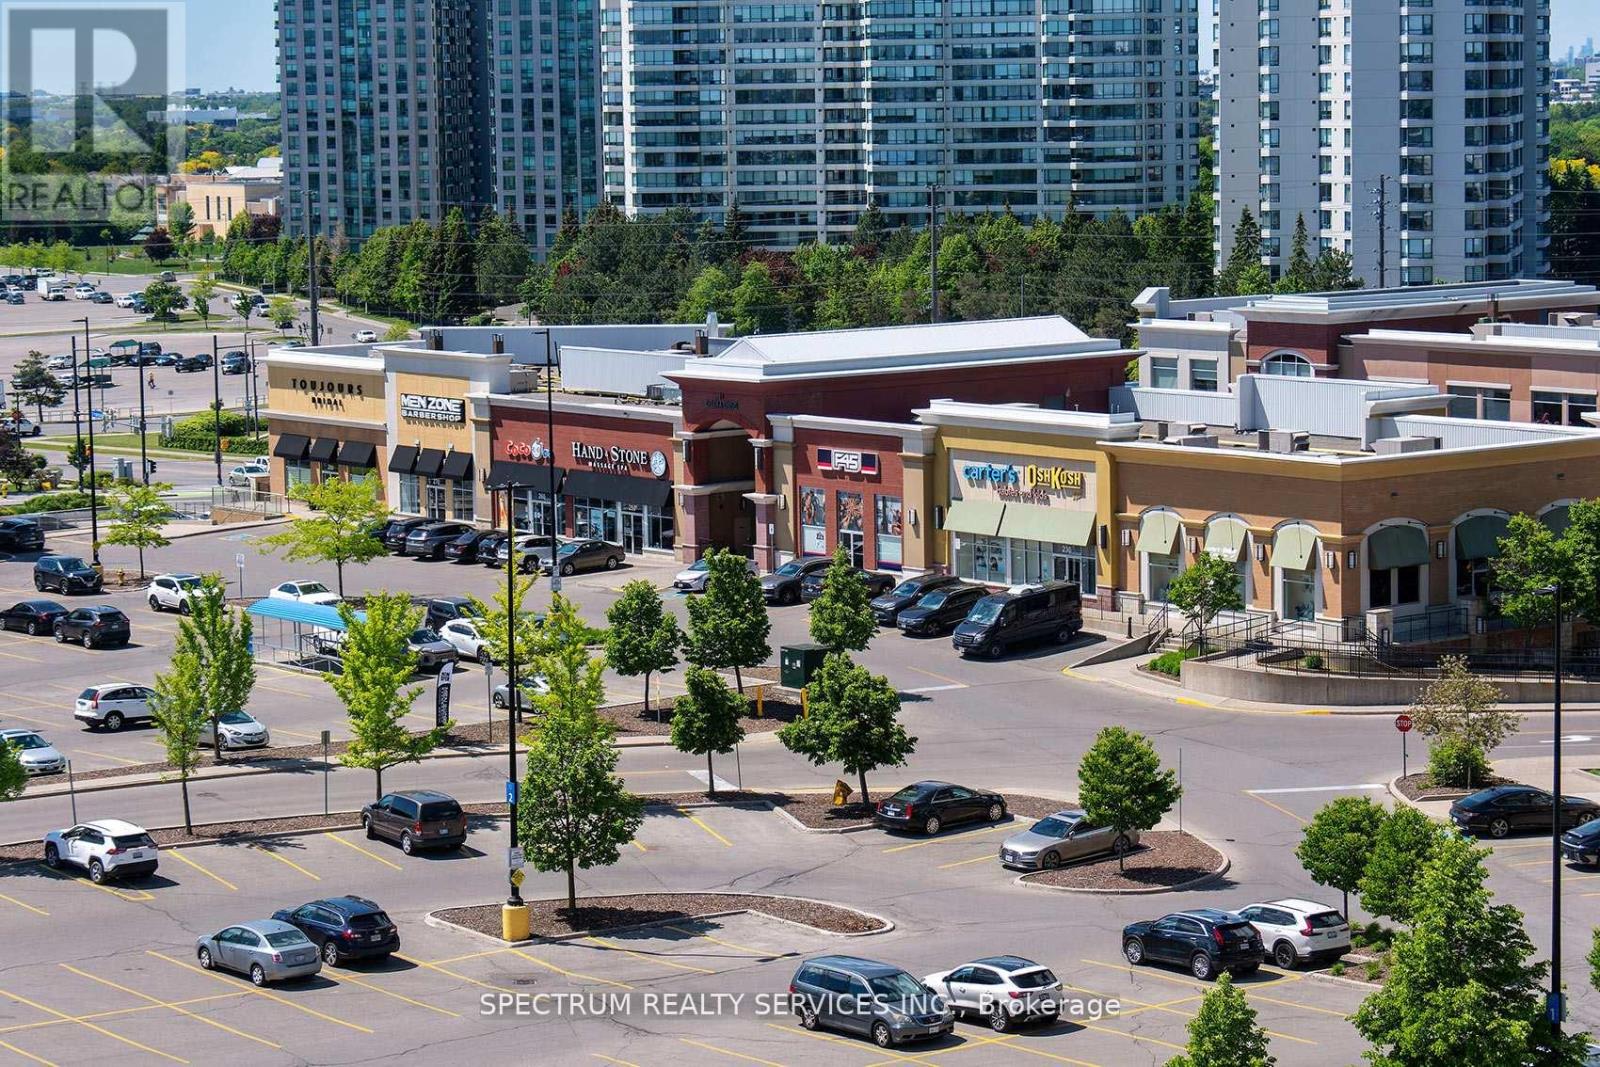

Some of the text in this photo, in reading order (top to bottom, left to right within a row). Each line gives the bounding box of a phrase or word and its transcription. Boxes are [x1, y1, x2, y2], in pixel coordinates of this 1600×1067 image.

[291, 378, 363, 396] TOUJOURS
[311, 396, 342, 407] BRIDAL
[401, 394, 463, 412] MEN ZONE
[401, 410, 461, 422] BARBERSHOP
[588, 461, 614, 470] MASSAGE
[834, 451, 859, 471] F45
[963, 463, 1017, 484] carter's
[1396, 719, 1411, 727] STOP
